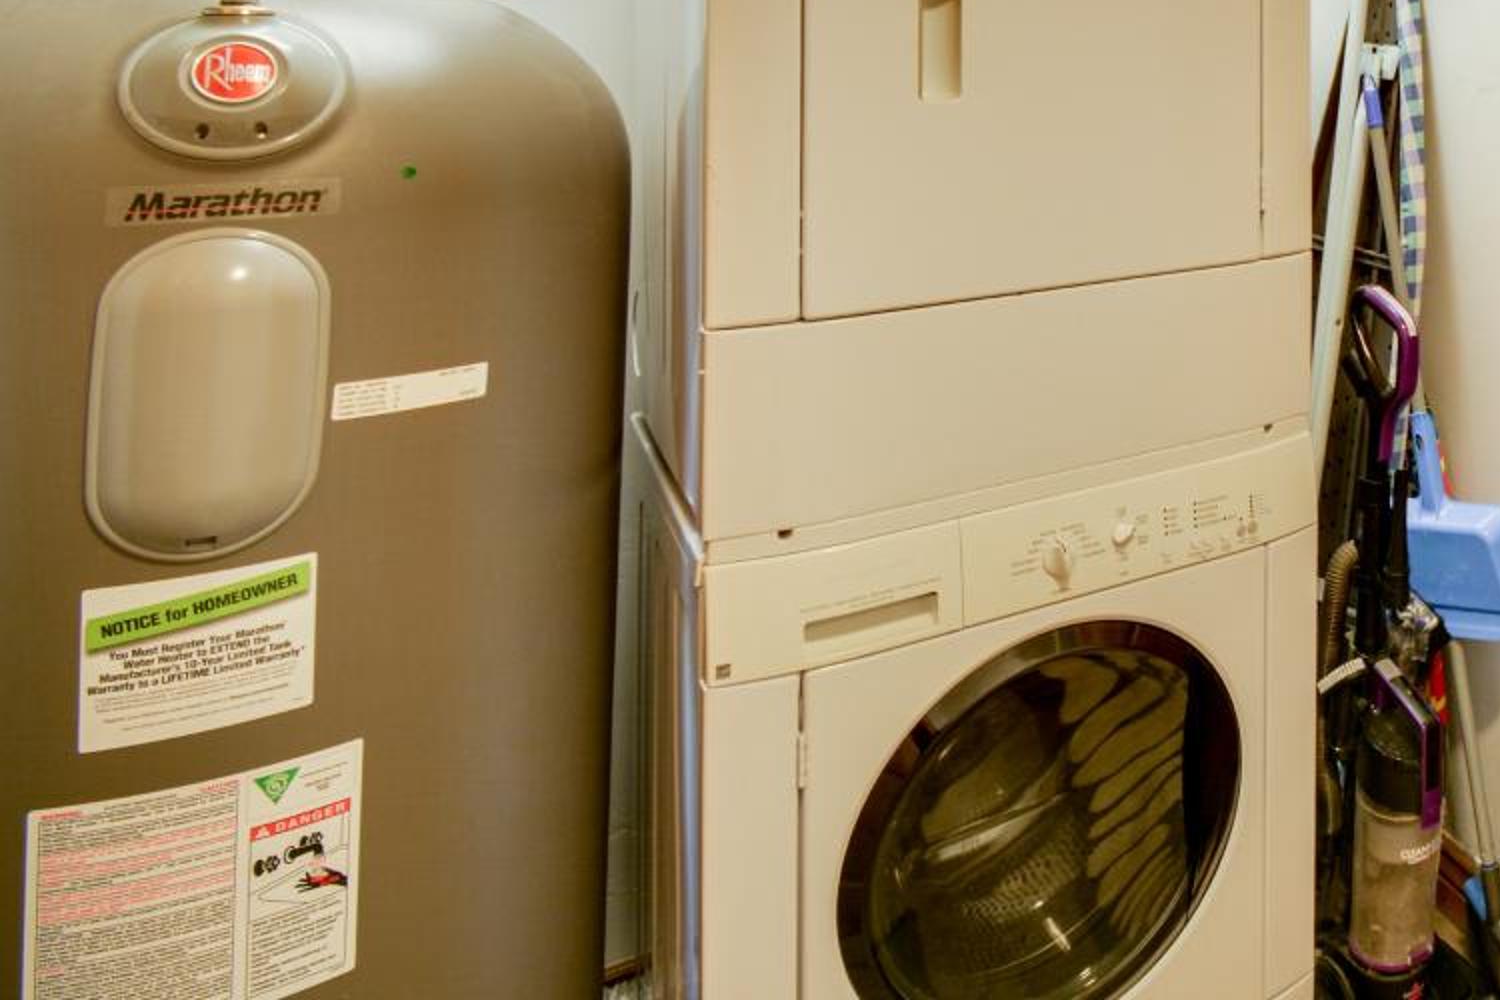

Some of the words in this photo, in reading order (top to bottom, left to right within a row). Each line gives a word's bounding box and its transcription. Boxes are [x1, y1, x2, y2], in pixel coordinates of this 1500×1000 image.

[204, 46, 271, 91] Rheem
[123, 187, 323, 222] Marathon
[100, 611, 161, 639] NOTICE
[165, 606, 189, 623] for
[193, 572, 299, 616] HOMEOWNER
[99, 664, 181, 684] Manufacturer's
[184, 656, 224, 669] 10-Year
[227, 646, 267, 661] Limited
[269, 640, 292, 652] Tank
[109, 650, 129, 661] You
[131, 646, 159, 658] Must
[161, 638, 205, 653] Register
[209, 633, 232, 644] Your
[123, 659, 155, 670] Water
[157, 652, 193, 664] Heater
[209, 638, 251, 655] EXTEND
[87, 682, 135, 696] Warranty
[161, 667, 210, 685] LIFETIME
[213, 659, 253, 675] Limited
[275, 803, 346, 834] DANGER
